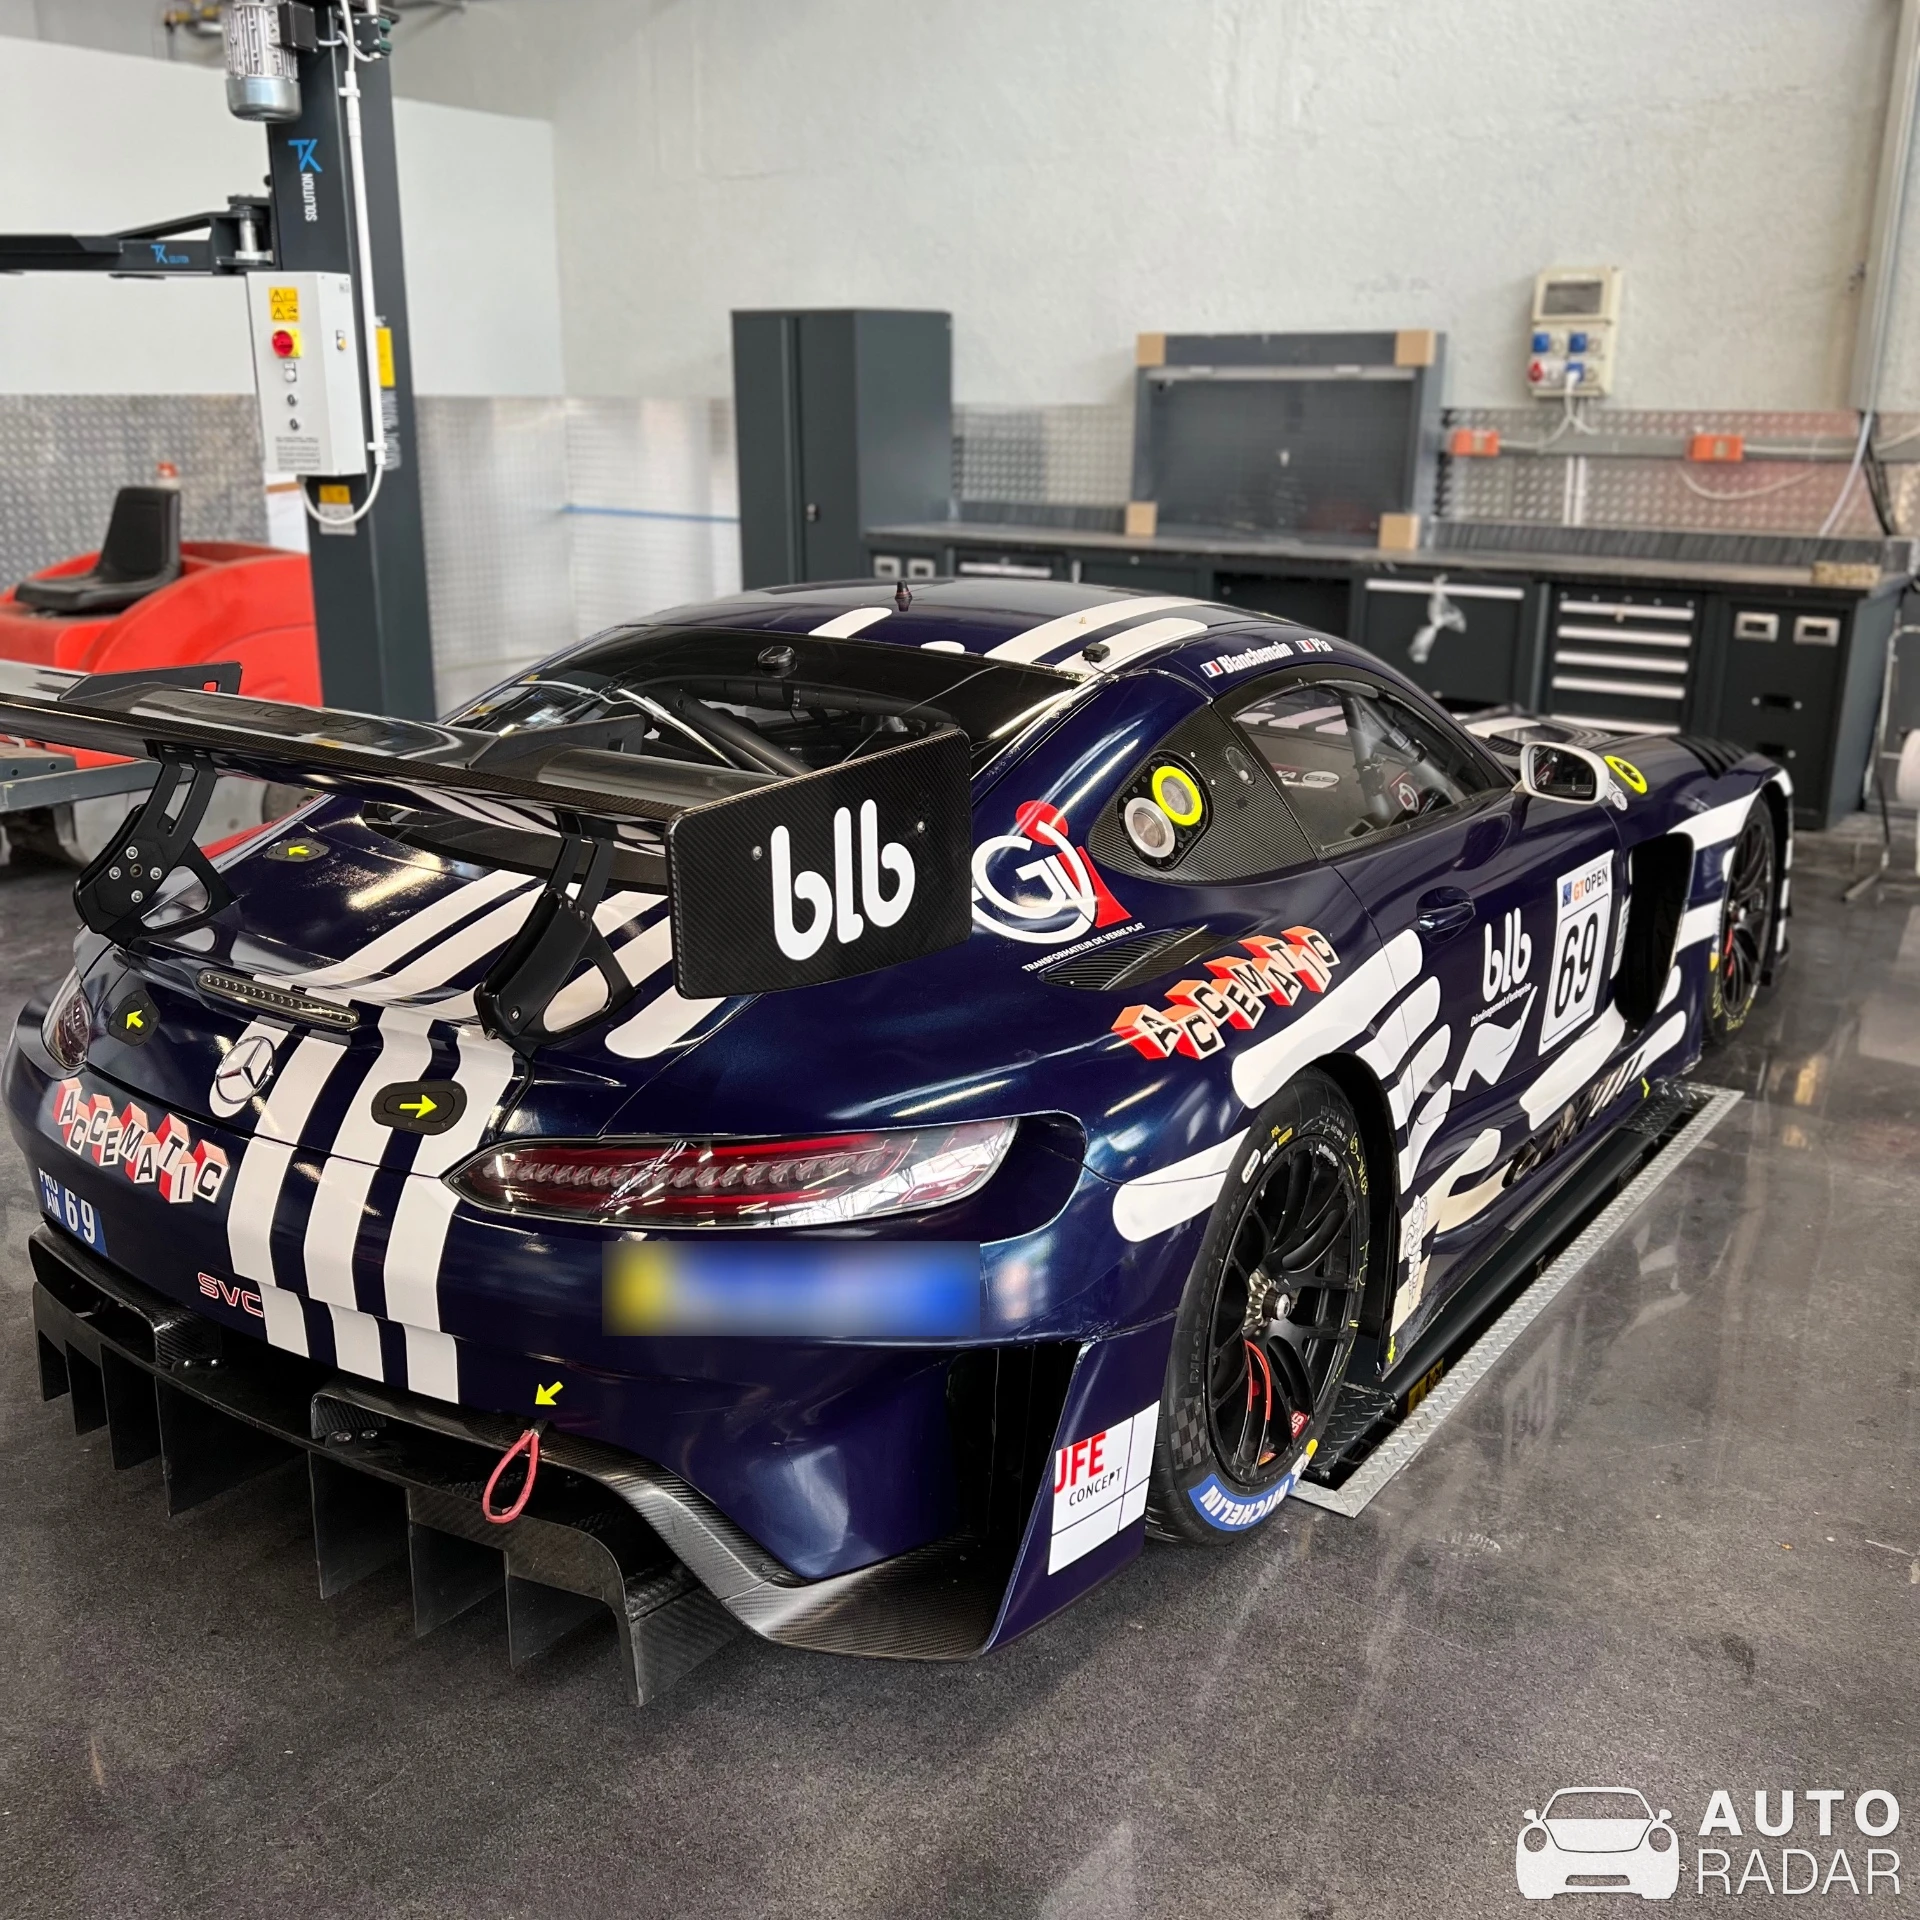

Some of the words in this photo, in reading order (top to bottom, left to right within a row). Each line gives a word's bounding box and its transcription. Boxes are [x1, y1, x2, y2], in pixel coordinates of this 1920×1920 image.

[302, 172, 318, 222] SOLUTION
[1216, 640, 1295, 674] Blanchemain
[1309, 637, 1334, 653] Pla
[770, 798, 916, 961] blb
[1021, 940, 1095, 972] TRANSFORMATEUR
[1091, 935, 1106, 946] DE
[1102, 928, 1129, 943] VERRE
[1126, 922, 1146, 935] PLAT
[1482, 907, 1532, 1002] blb
[1554, 912, 1599, 1019] 69
[1136, 931, 1337, 1055] ACCEMATIC
[57, 1087, 225, 1201] ACCEMATIC
[46, 1188, 61, 1219] AM
[64, 1187, 96, 1245] 69
[197, 1271, 265, 1318] SVC
[1053, 1431, 1107, 1494] JFE
[1069, 1466, 1122, 1507] CONCEPT
[1199, 1478, 1291, 1526] MICHELIN
